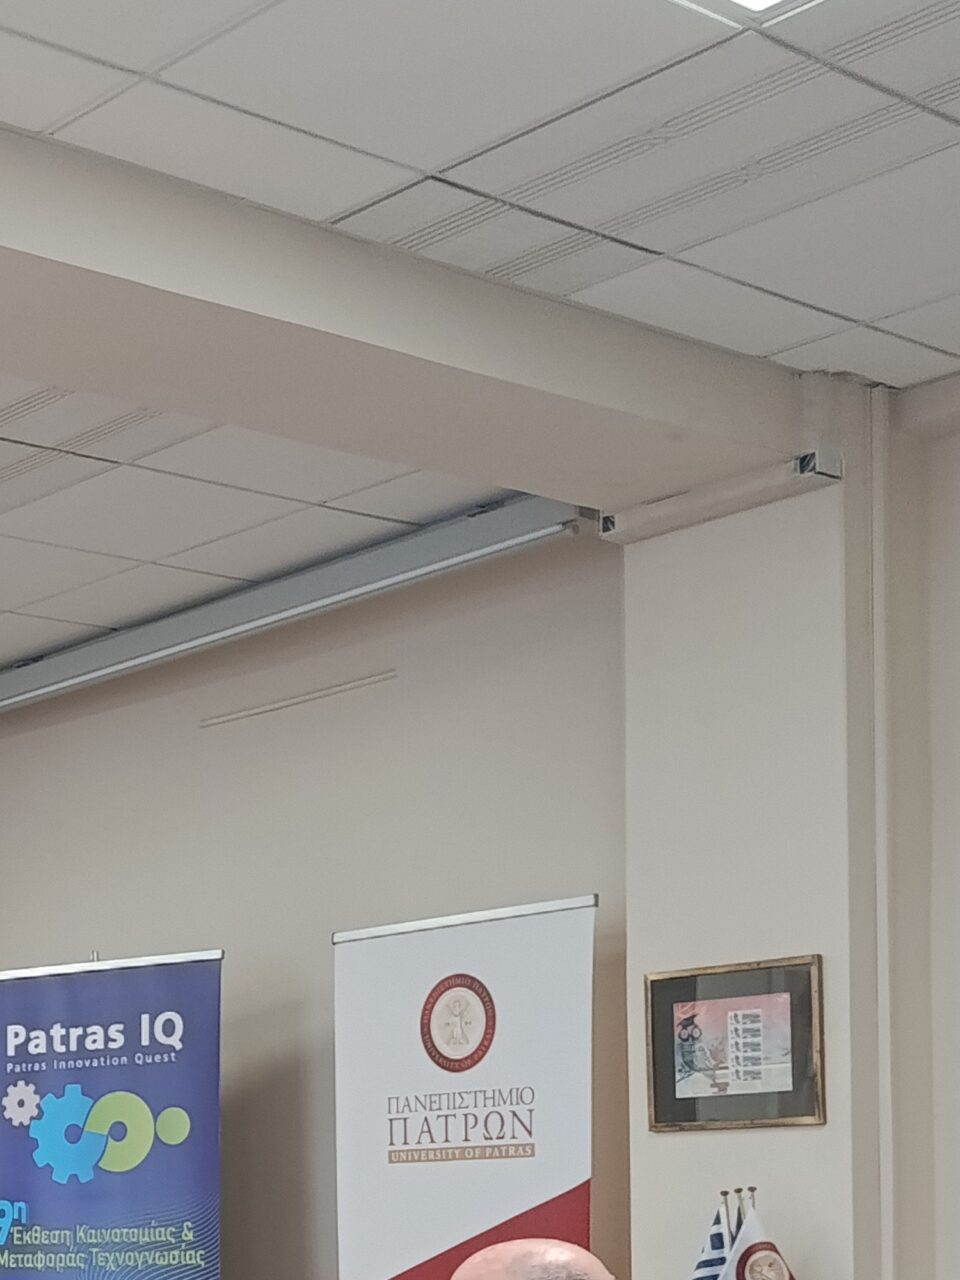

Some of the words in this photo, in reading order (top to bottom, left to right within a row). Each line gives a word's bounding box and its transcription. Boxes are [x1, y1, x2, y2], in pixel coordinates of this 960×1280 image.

[6, 1022, 125, 1057] Patras
[140, 1011, 184, 1051] IQ
[6, 1061, 47, 1073] Patras
[53, 1055, 128, 1070] Innovation
[134, 1052, 177, 1064] Quest
[387, 1086, 535, 1114] ΠΑΝΕΠΙΣΤΗΜΙΟ
[387, 1109, 535, 1146] ΠΑΤΡΩΝ
[391, 1149, 461, 1162] UNIVERSITY
[464, 1148, 481, 1158] OF
[486, 1145, 532, 1157] PATRAS
[10, 1225, 73, 1250] Έκθεση
[76, 1220, 177, 1246] Καινοτομίας
[181, 1221, 194, 1242] &
[89, 1243, 206, 1272] Τεχνογνωσίας
